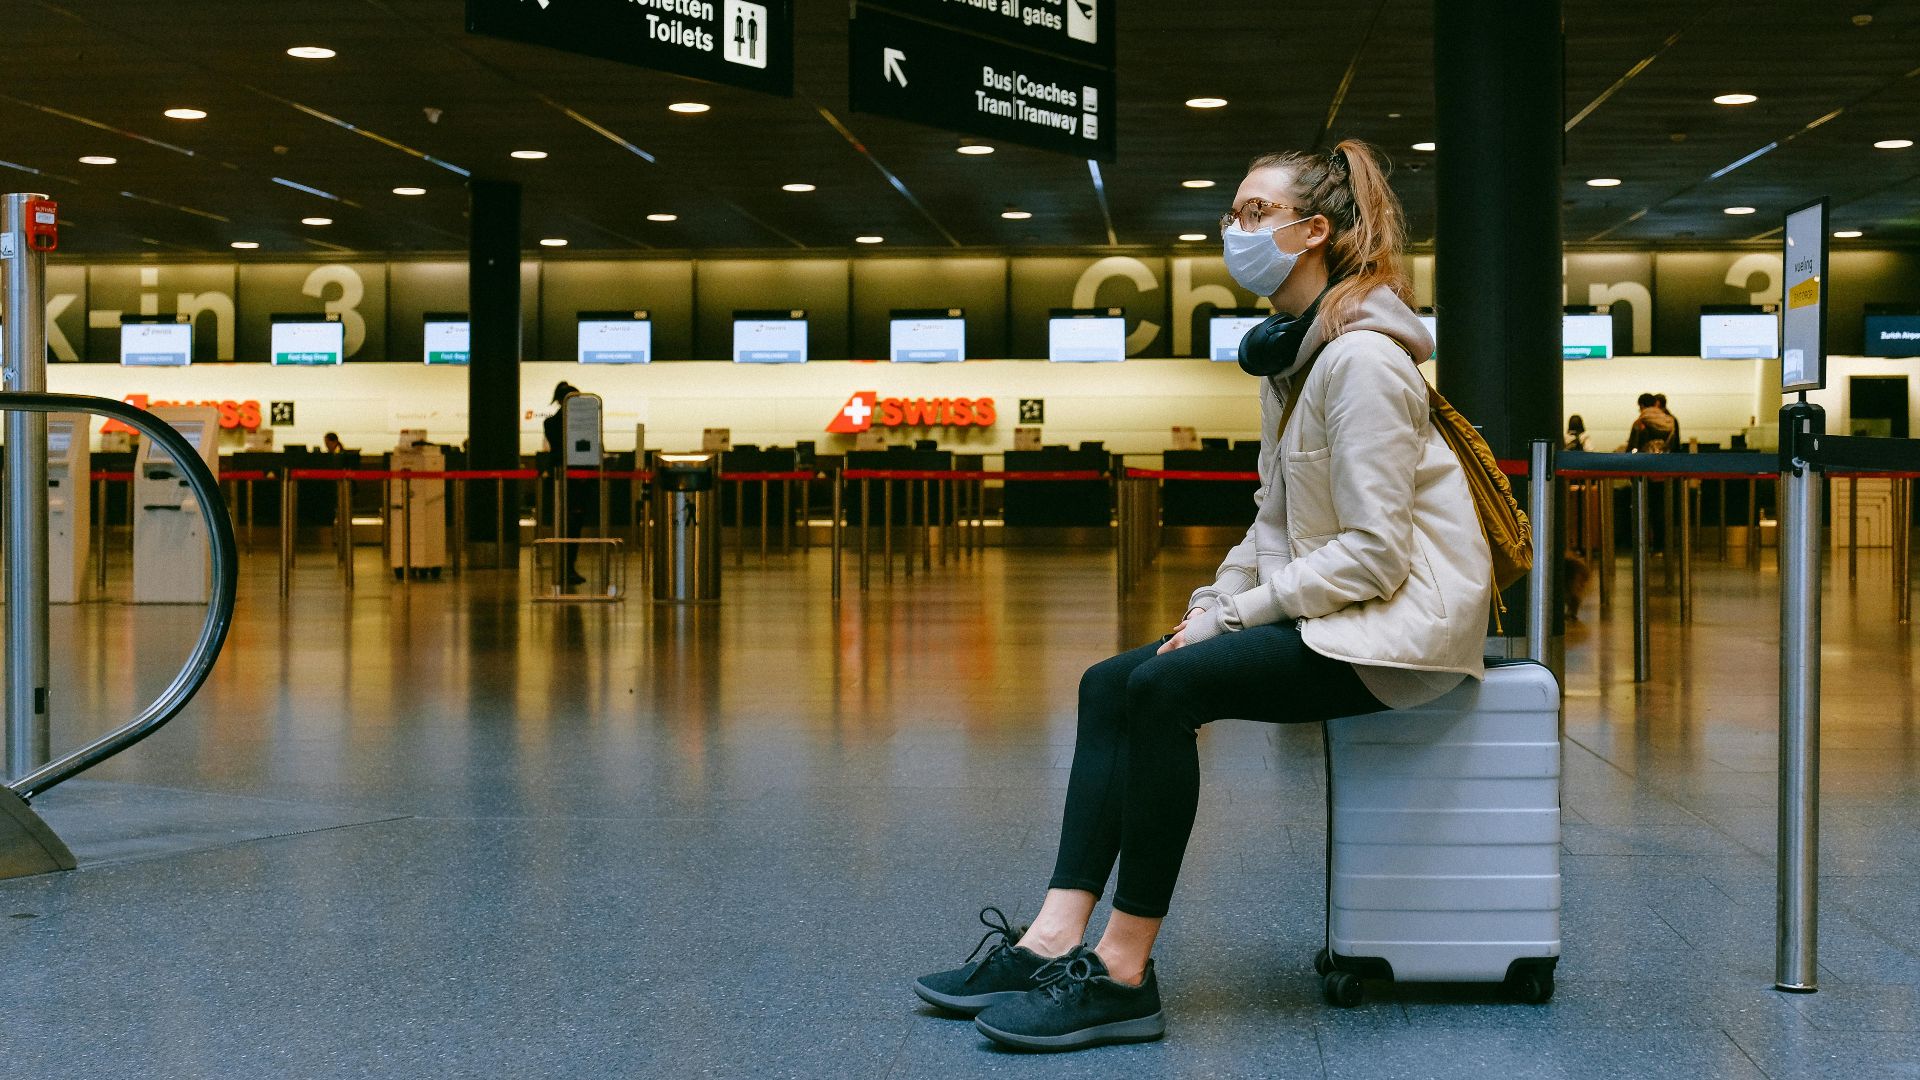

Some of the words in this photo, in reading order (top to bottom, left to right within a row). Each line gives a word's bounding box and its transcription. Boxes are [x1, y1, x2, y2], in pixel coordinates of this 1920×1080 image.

[645, 13, 714, 52] Toilets
[1022, 6, 1062, 30] gates
[1016, 74, 1077, 107] Coaches
[1016, 99, 1078, 136] Tramway
[1794, 256, 1813, 274] vueling
[302, 264, 367, 358] 3
[881, 398, 996, 426] SWISS
